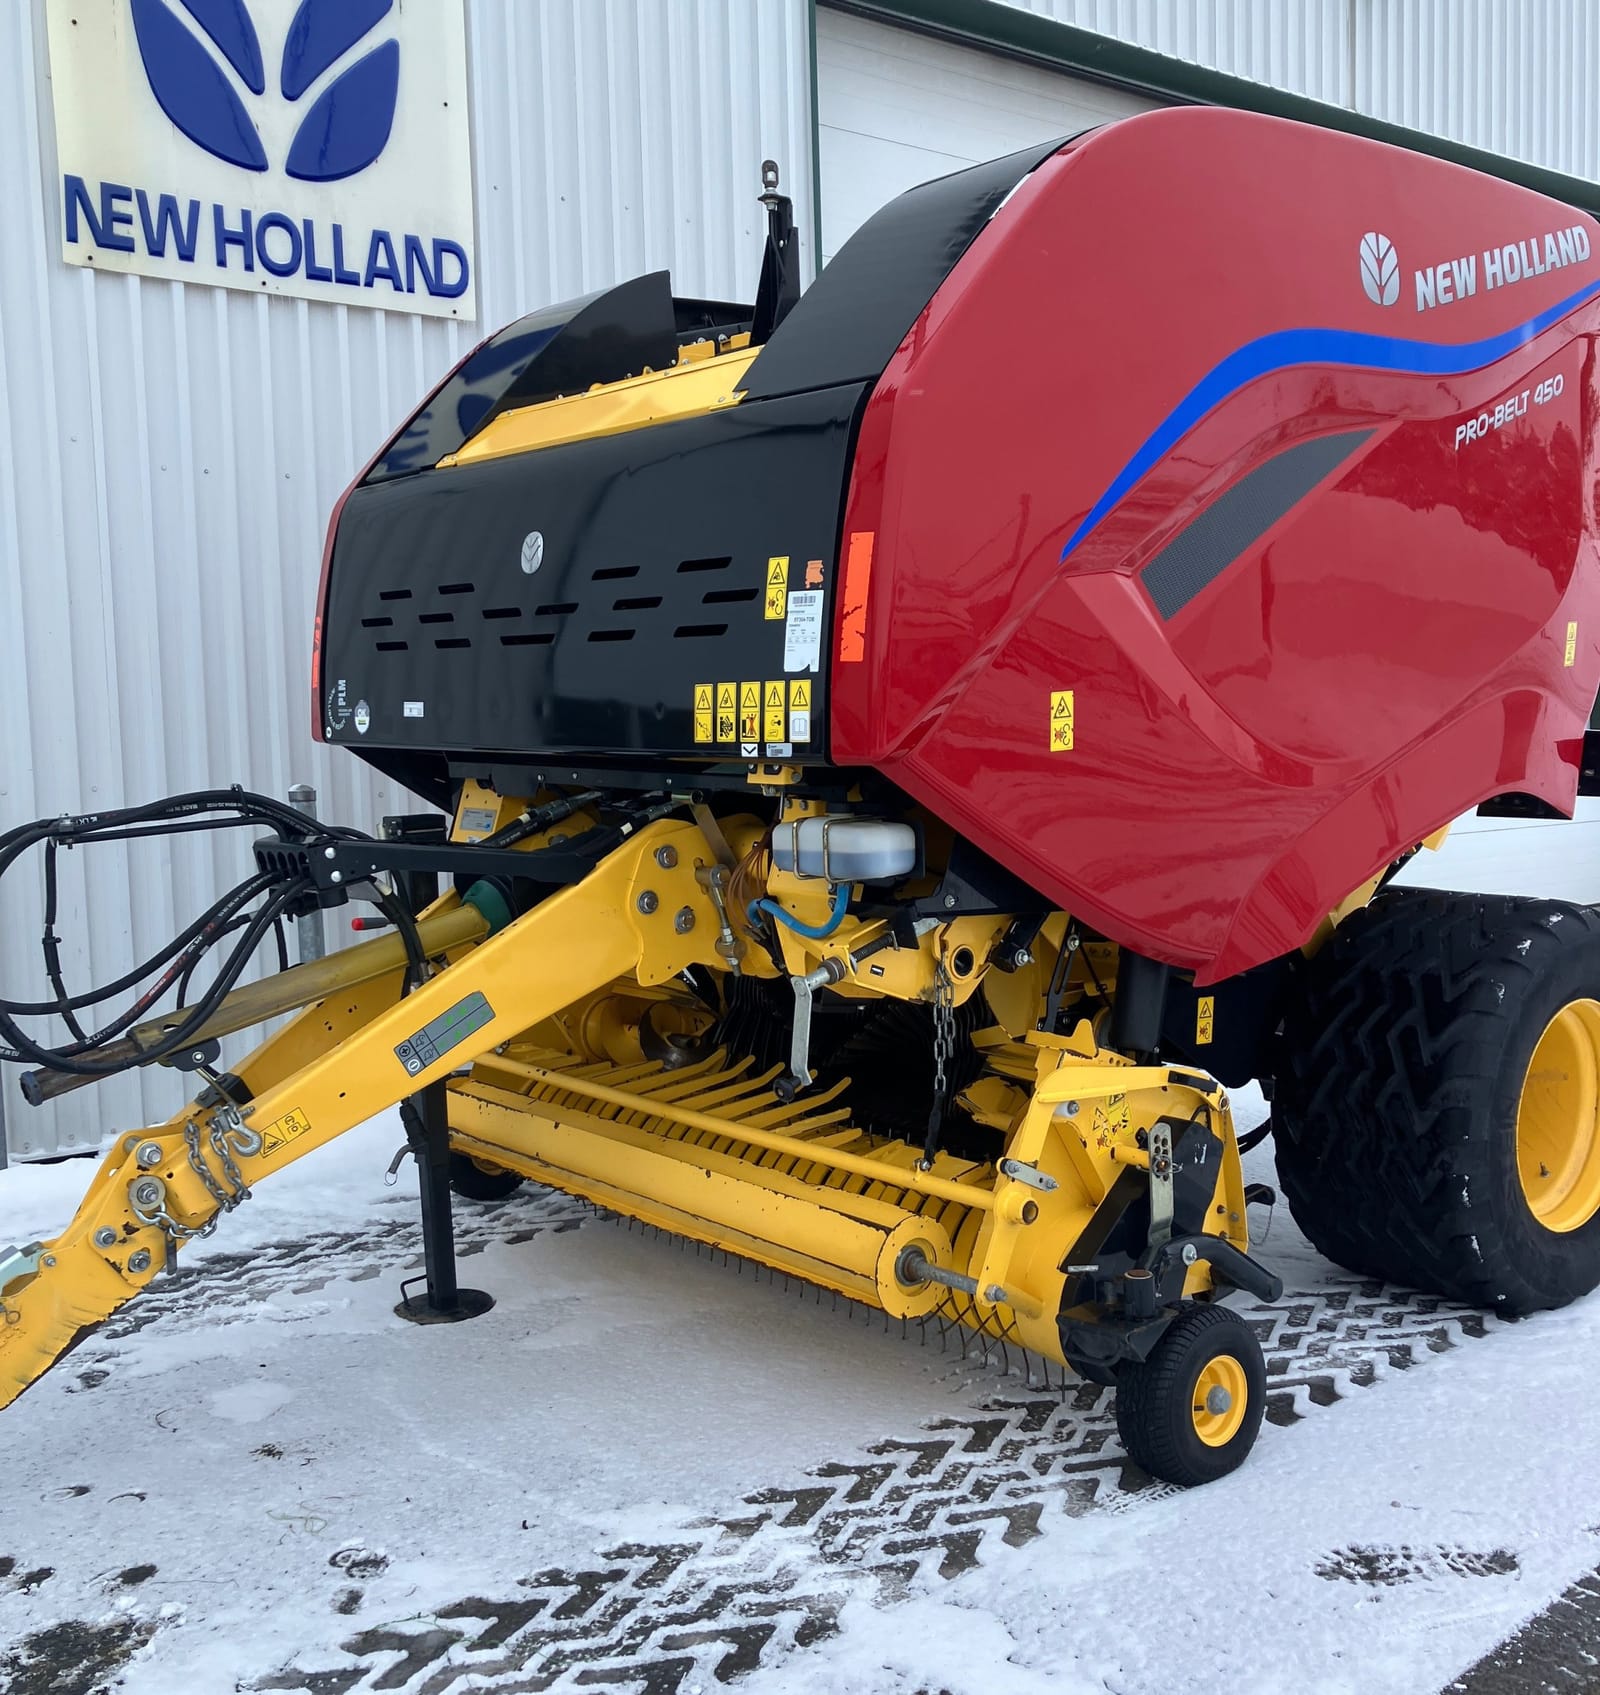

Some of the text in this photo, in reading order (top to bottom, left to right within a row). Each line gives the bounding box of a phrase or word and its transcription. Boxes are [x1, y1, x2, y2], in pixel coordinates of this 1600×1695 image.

[63, 174, 470, 298] NEW HOLLAND
[1414, 224, 1592, 312] NEW HOLLAND
[1455, 373, 1565, 451] PRO-BELT 450
[337, 679, 347, 706] PLM
